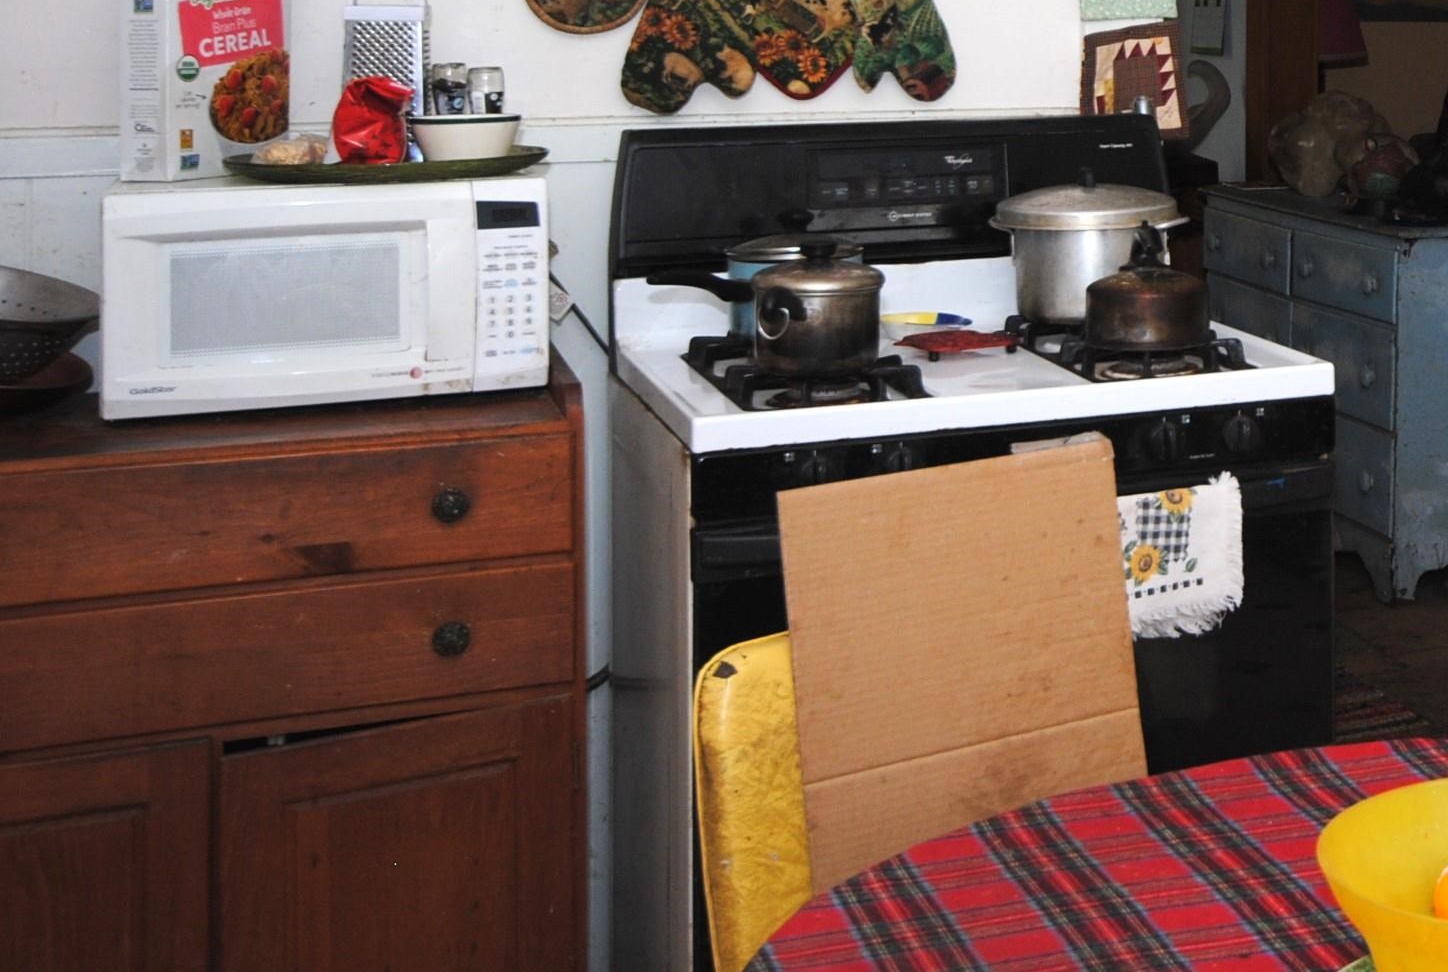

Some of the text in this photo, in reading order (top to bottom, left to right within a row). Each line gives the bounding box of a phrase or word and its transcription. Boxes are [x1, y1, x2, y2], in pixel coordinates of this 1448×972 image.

[212, 20, 235, 34] Bran
[198, 28, 272, 58] CEREAL
[129, 386, 176, 396] GoldStar
